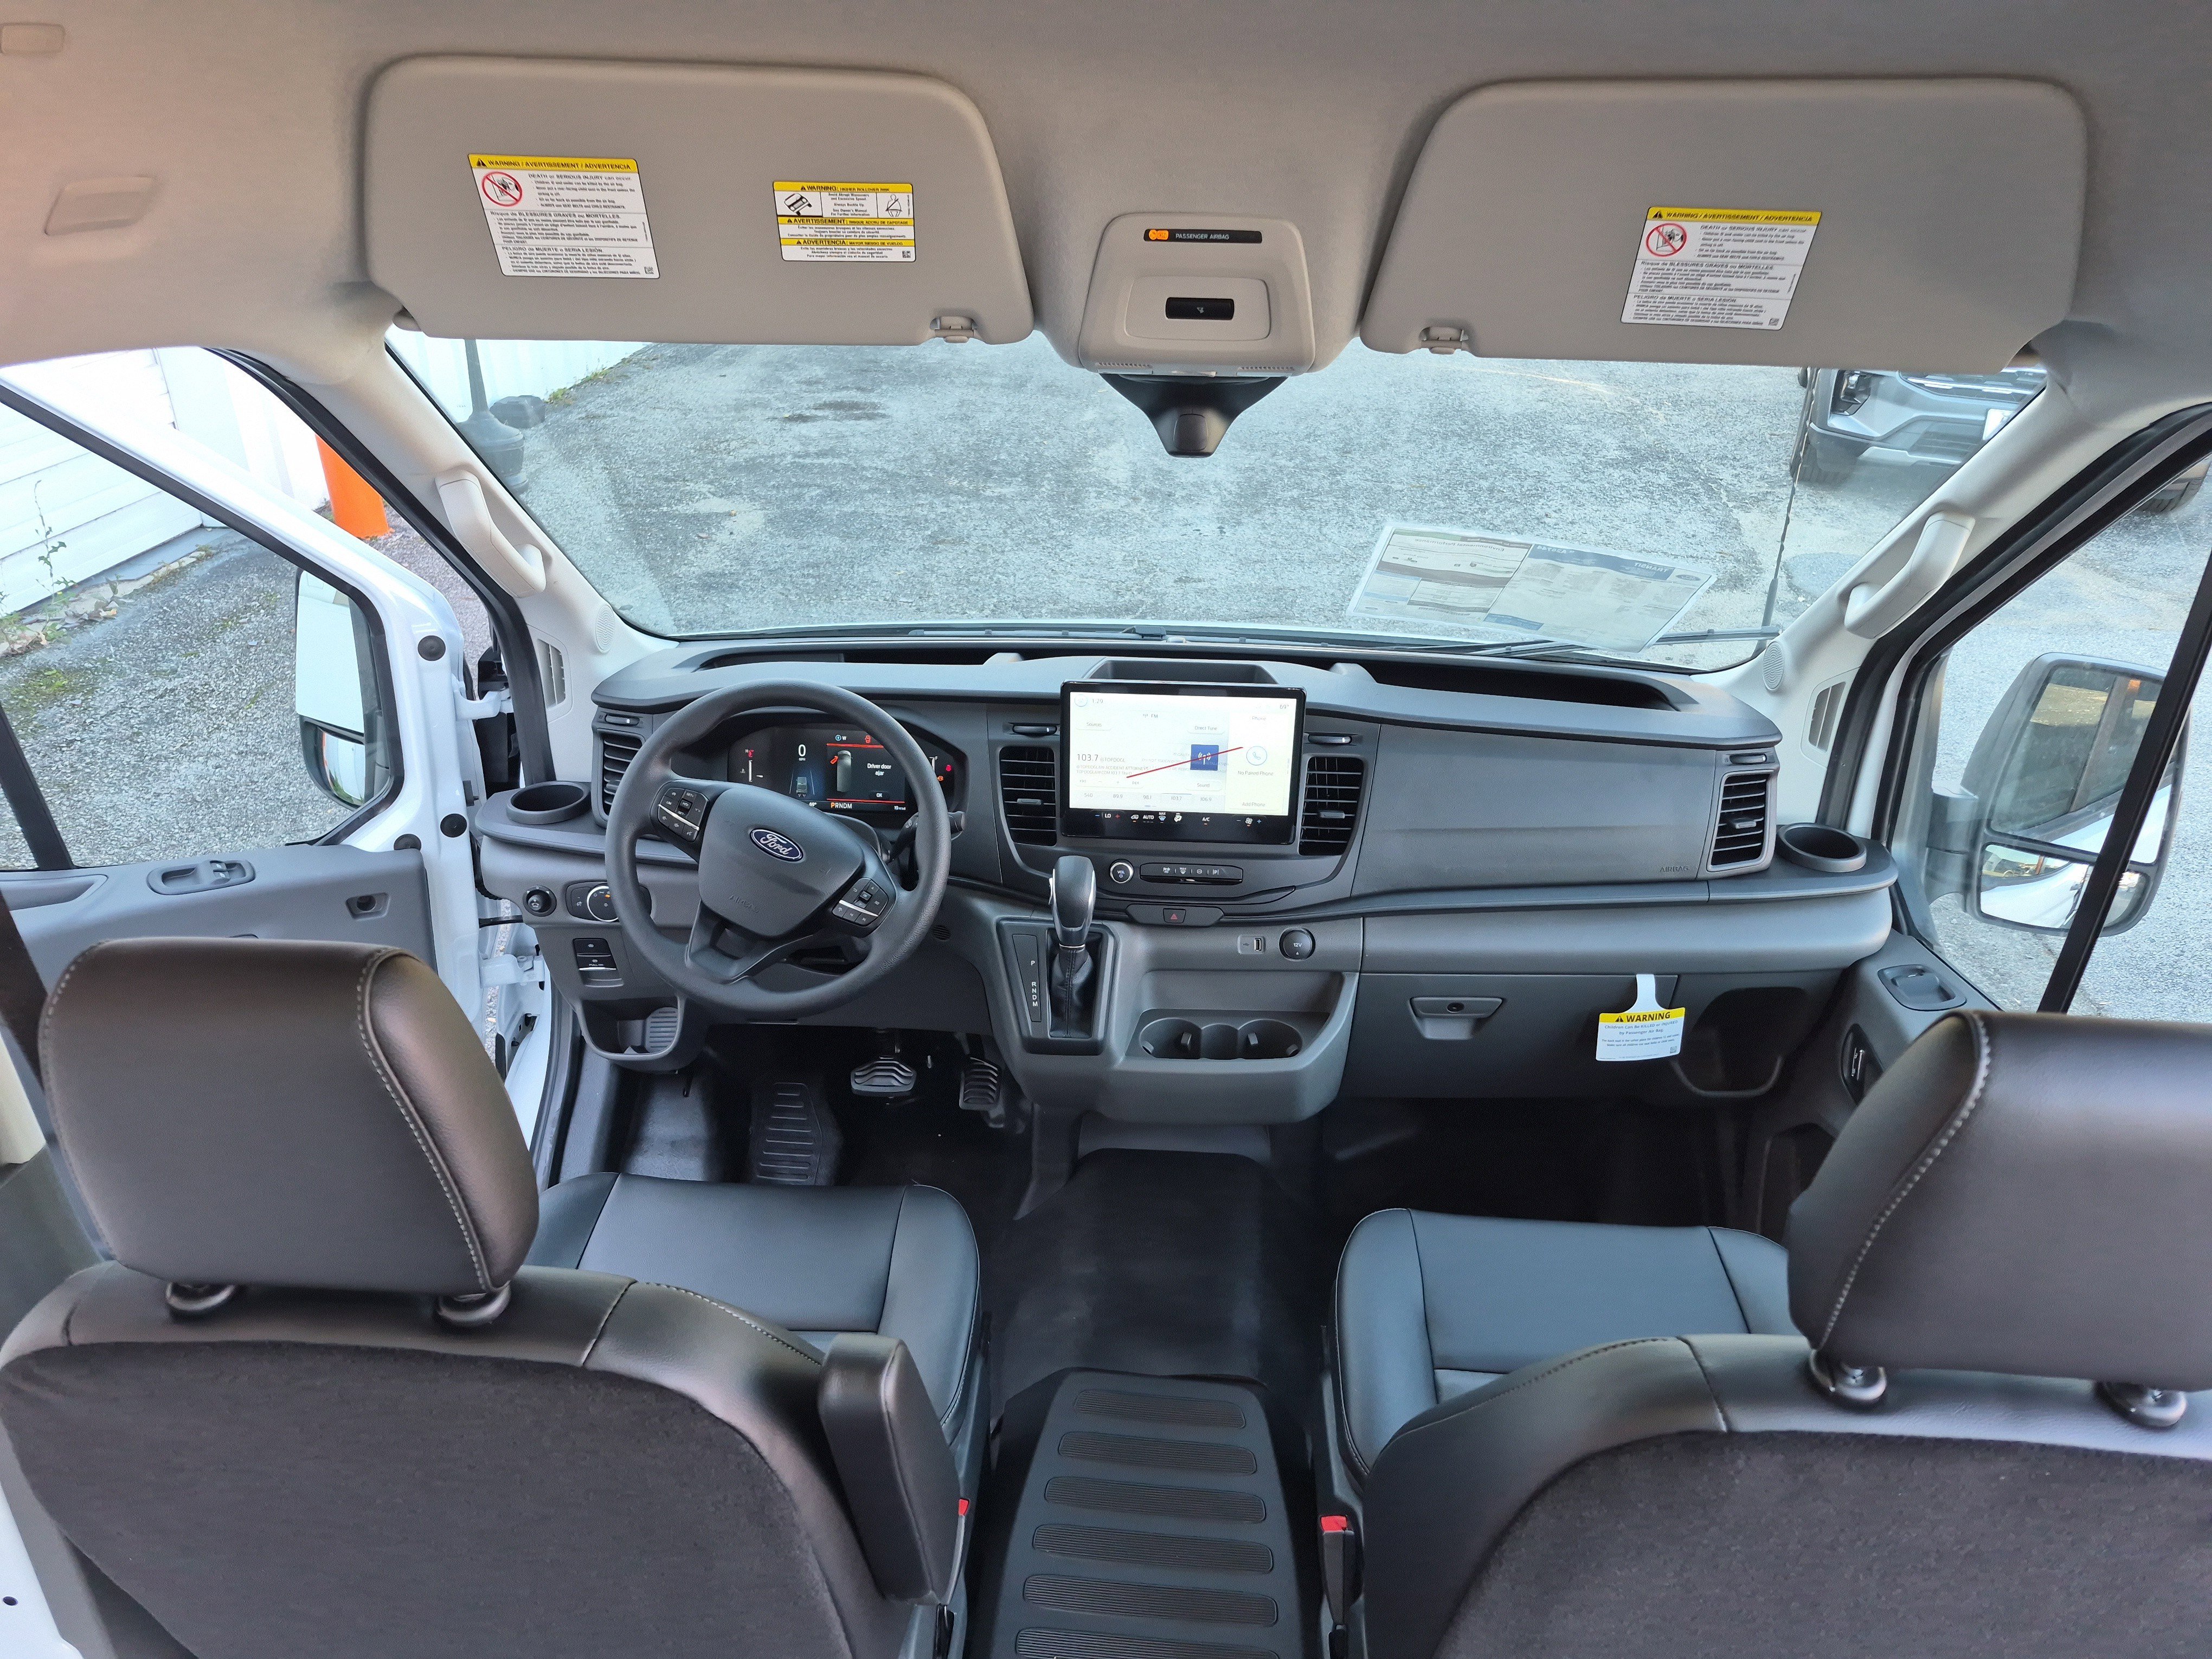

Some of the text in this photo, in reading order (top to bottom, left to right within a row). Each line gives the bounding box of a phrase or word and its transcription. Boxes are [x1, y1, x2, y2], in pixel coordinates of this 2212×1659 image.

[798, 744, 806, 757] 0
[1077, 754, 1098, 762] 103.7
[760, 833, 793, 855] Ford
[1626, 1012, 1671, 1023] WARNING
